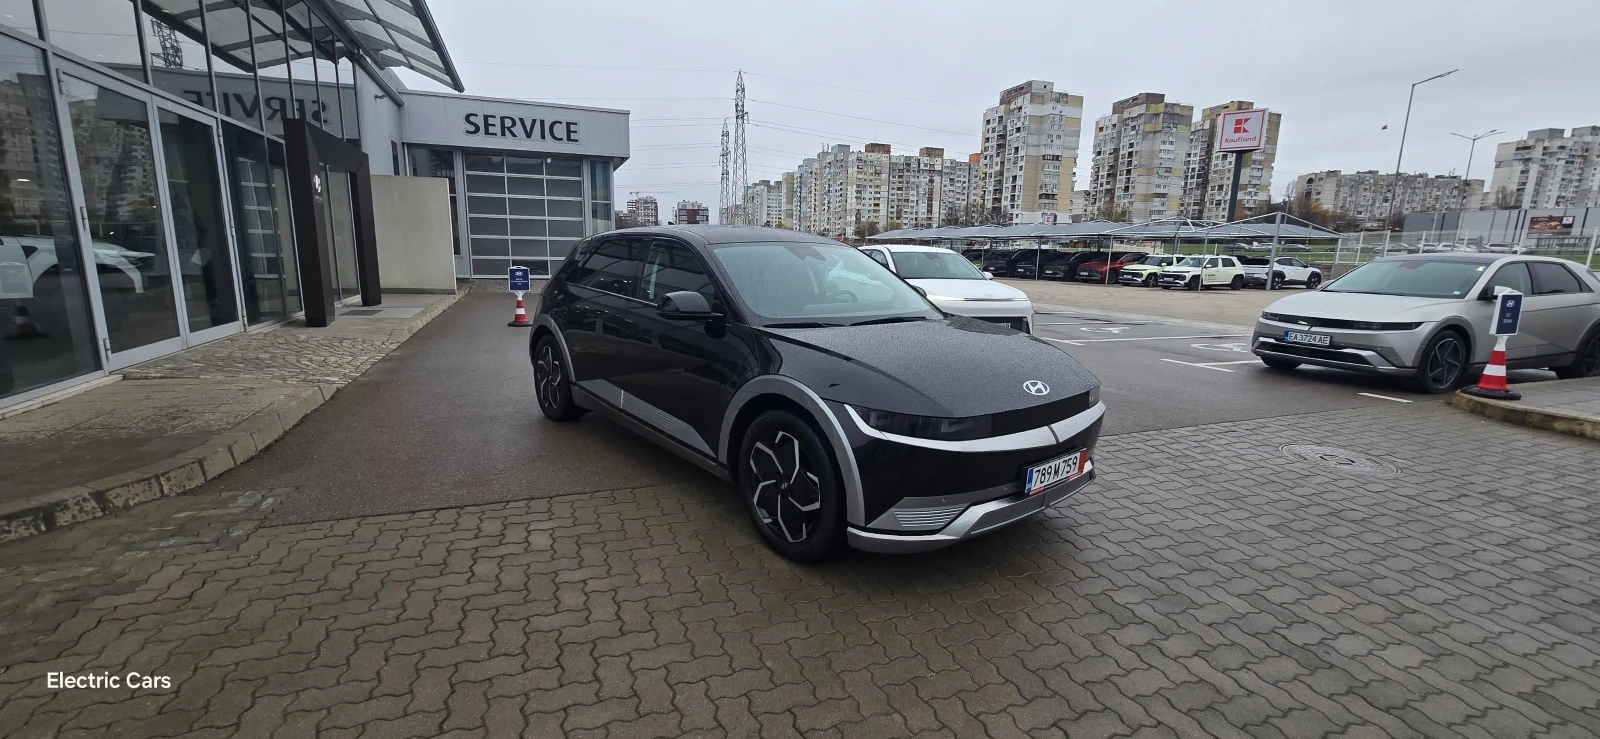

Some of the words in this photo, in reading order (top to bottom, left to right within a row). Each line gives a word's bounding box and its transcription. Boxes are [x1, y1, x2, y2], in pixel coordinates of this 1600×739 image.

[464, 112, 579, 143] SERVICE
[1225, 135, 1257, 143] Kaufland
[1288, 332, 1298, 341] EA
[1298, 333, 1317, 343] 3724
[1317, 336, 1328, 345] AE
